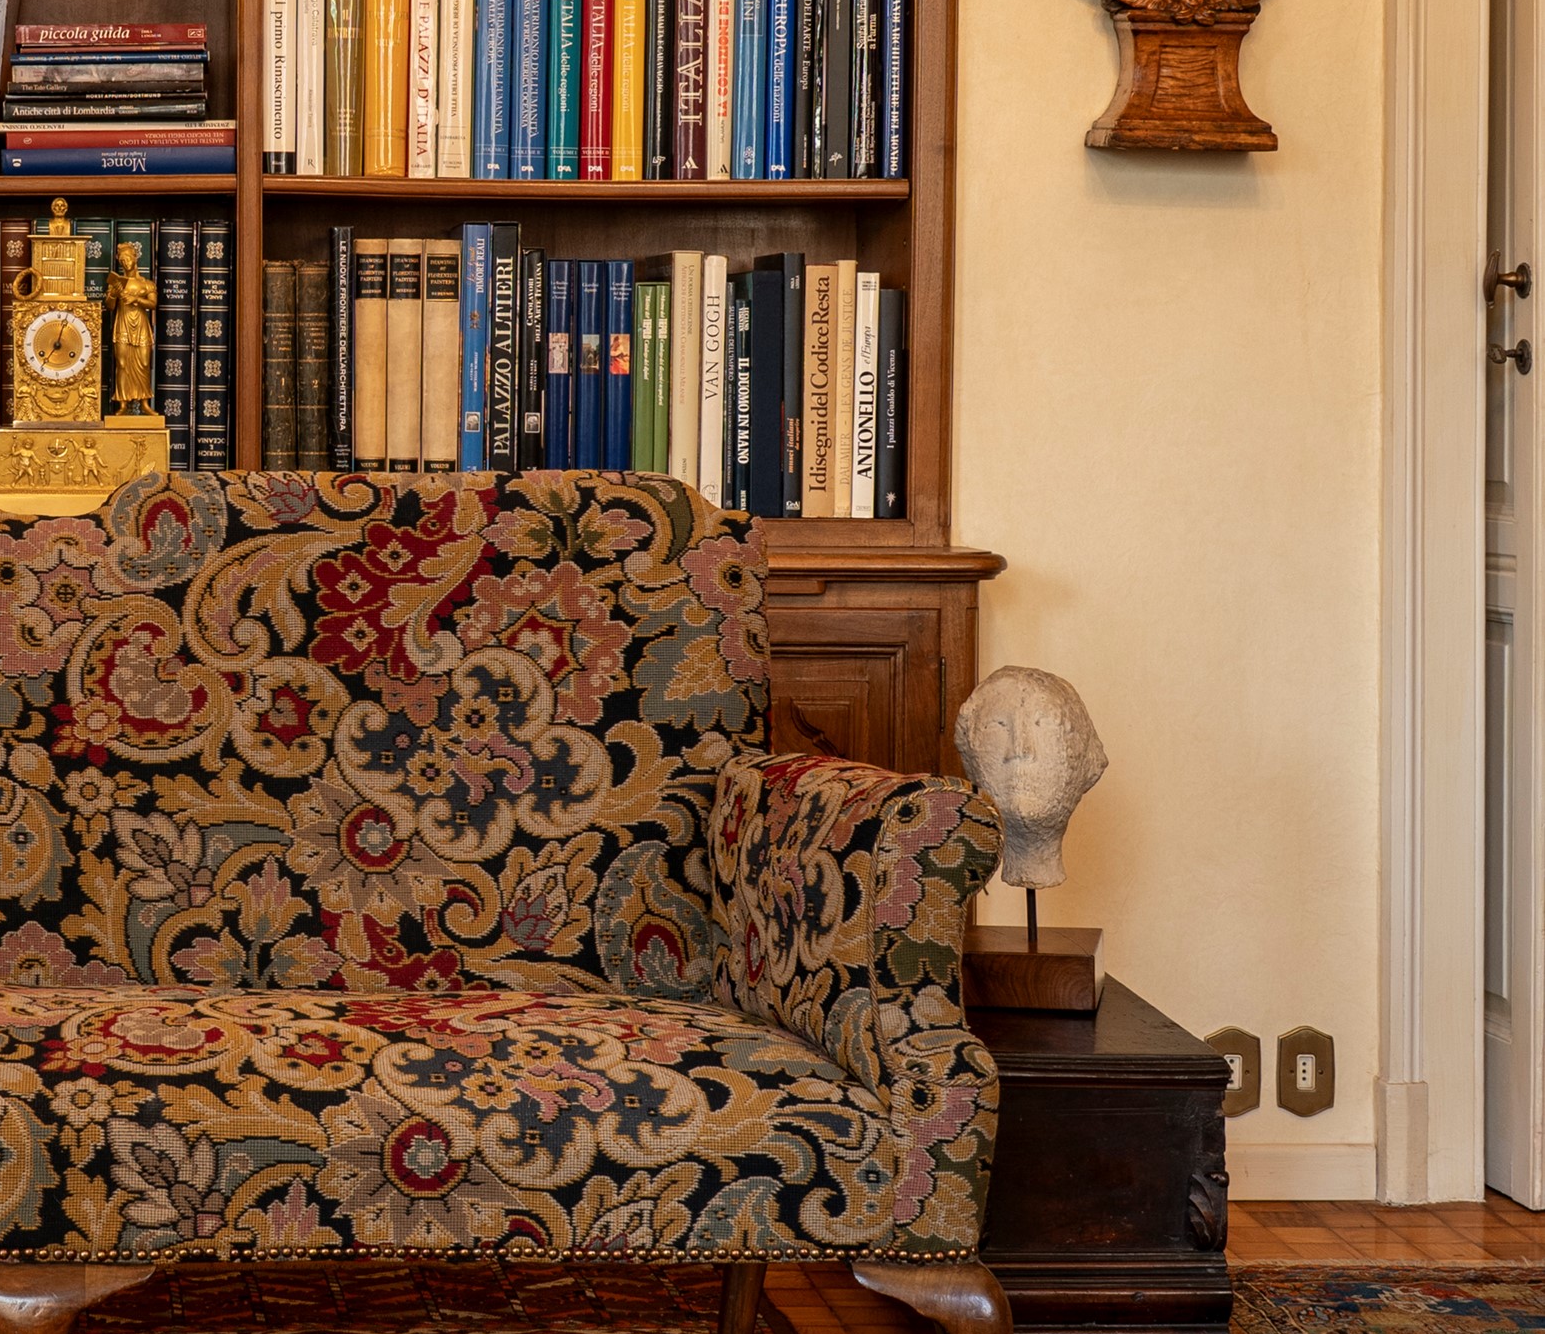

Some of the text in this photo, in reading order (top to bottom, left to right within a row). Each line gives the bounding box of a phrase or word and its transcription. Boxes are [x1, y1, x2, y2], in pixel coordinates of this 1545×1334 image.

[720, 3, 729, 15] DI
[39, 27, 130, 42] piccola guida
[270, 11, 285, 48] primo
[311, 10, 319, 46] Calatrava
[561, 52, 569, 76] delle
[718, 19, 728, 98] COLLEZIONE
[801, 61, 810, 90] Europa
[891, 27, 900, 110] ARCHITETTURE
[13, 106, 115, 116] Antiche città di Lombardia
[274, 56, 285, 139] Rinascimento
[559, 78, 569, 111] regioni
[718, 102, 727, 117] LA
[891, 112, 899, 131] DEL
[102, 157, 146, 171] Monet
[890, 135, 899, 172] MONDO
[339, 241, 346, 252] LE
[477, 238, 485, 293] DIMORE REALI
[526, 278, 534, 325] CAPOLAVORI
[812, 276, 829, 324] Resta
[494, 256, 513, 455] PALAZZO ALTIERI
[704, 295, 720, 400] VAN GOGH
[811, 327, 828, 388] Codice
[888, 349, 896, 377] Vicenza
[840, 289, 852, 484] DAUMIER LES GENS DE JUSTICE
[888, 379, 895, 387] di
[737, 357, 749, 463] IL DUOMO IN MANO
[811, 392, 828, 419] del
[887, 389, 895, 416] Gualdo
[786, 417, 794, 447] italiani
[858, 371, 874, 479] ANTONELLO
[887, 418, 896, 442] palazzi
[809, 421, 831, 482] disegni
